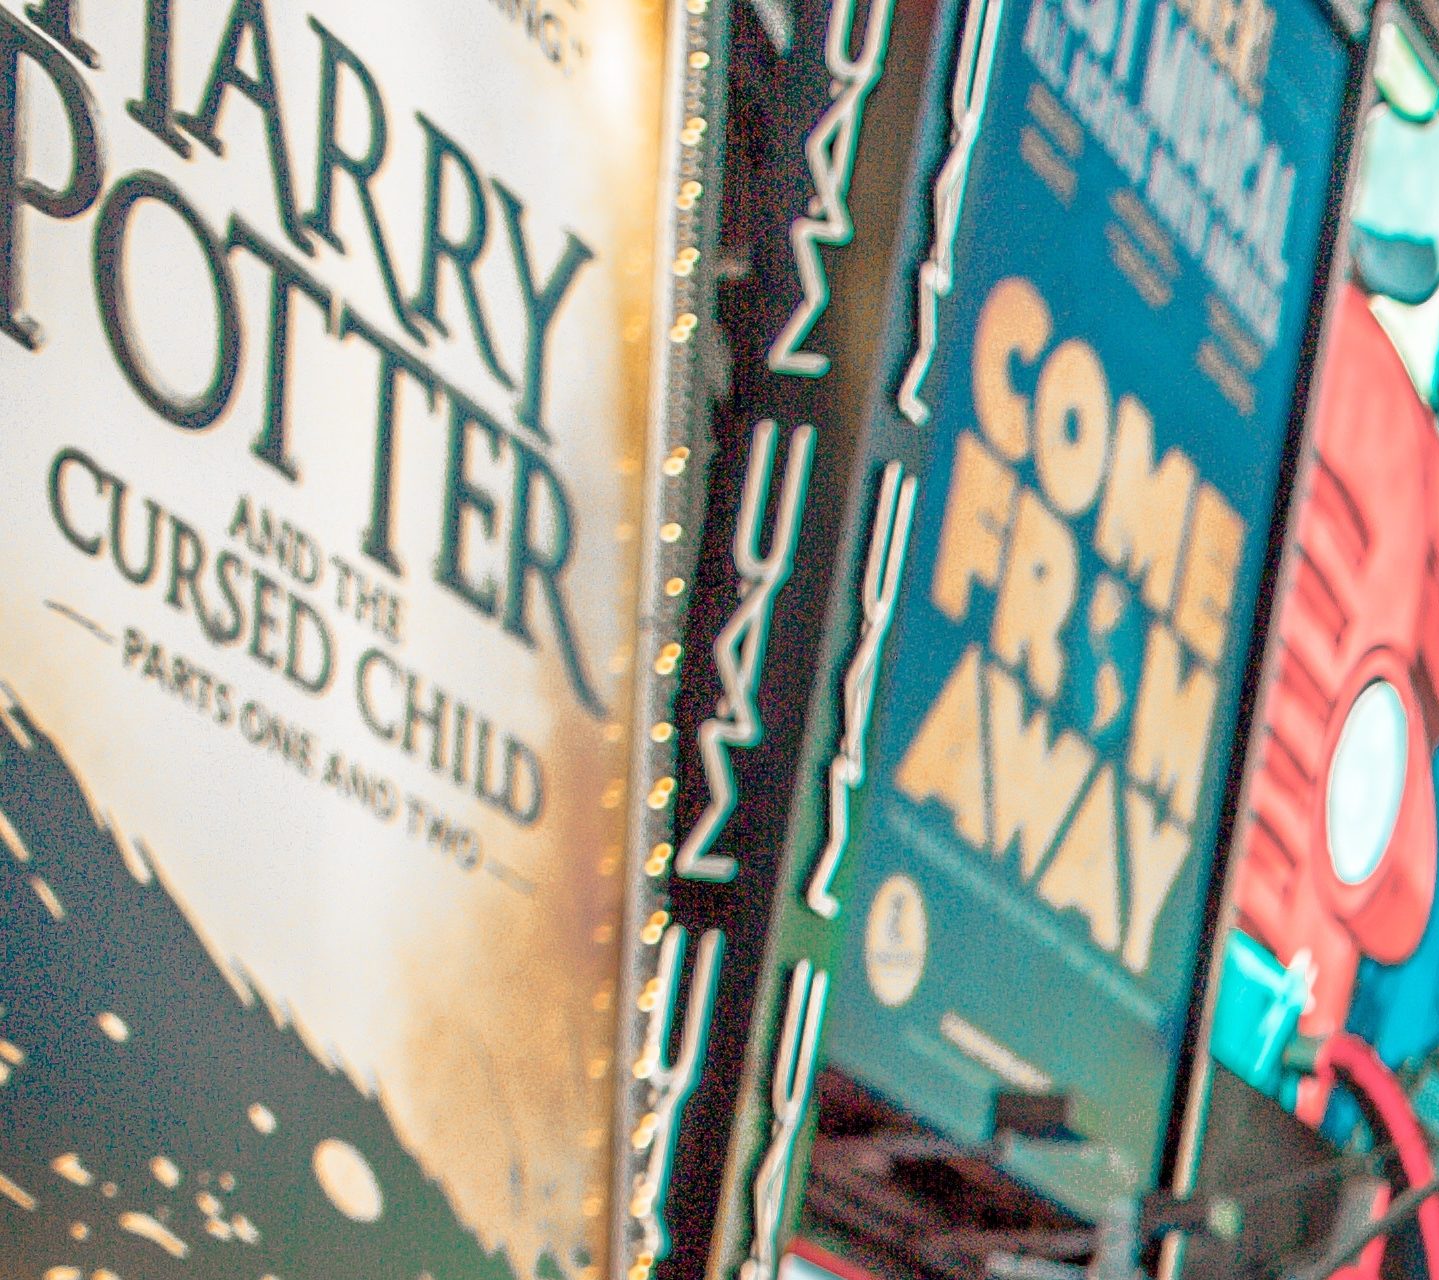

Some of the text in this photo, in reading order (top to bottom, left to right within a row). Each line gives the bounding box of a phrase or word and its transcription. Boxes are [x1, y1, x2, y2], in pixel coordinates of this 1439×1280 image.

[0, 14, 608, 720] POTTER
[972, 276, 1247, 668] COME
[47, 447, 546, 830] CURSED CHILD
[229, 492, 408, 641] AND THE
[122, 626, 485, 875] PARTS ONE AND TWO
[893, 643, 1193, 976] AWAY
